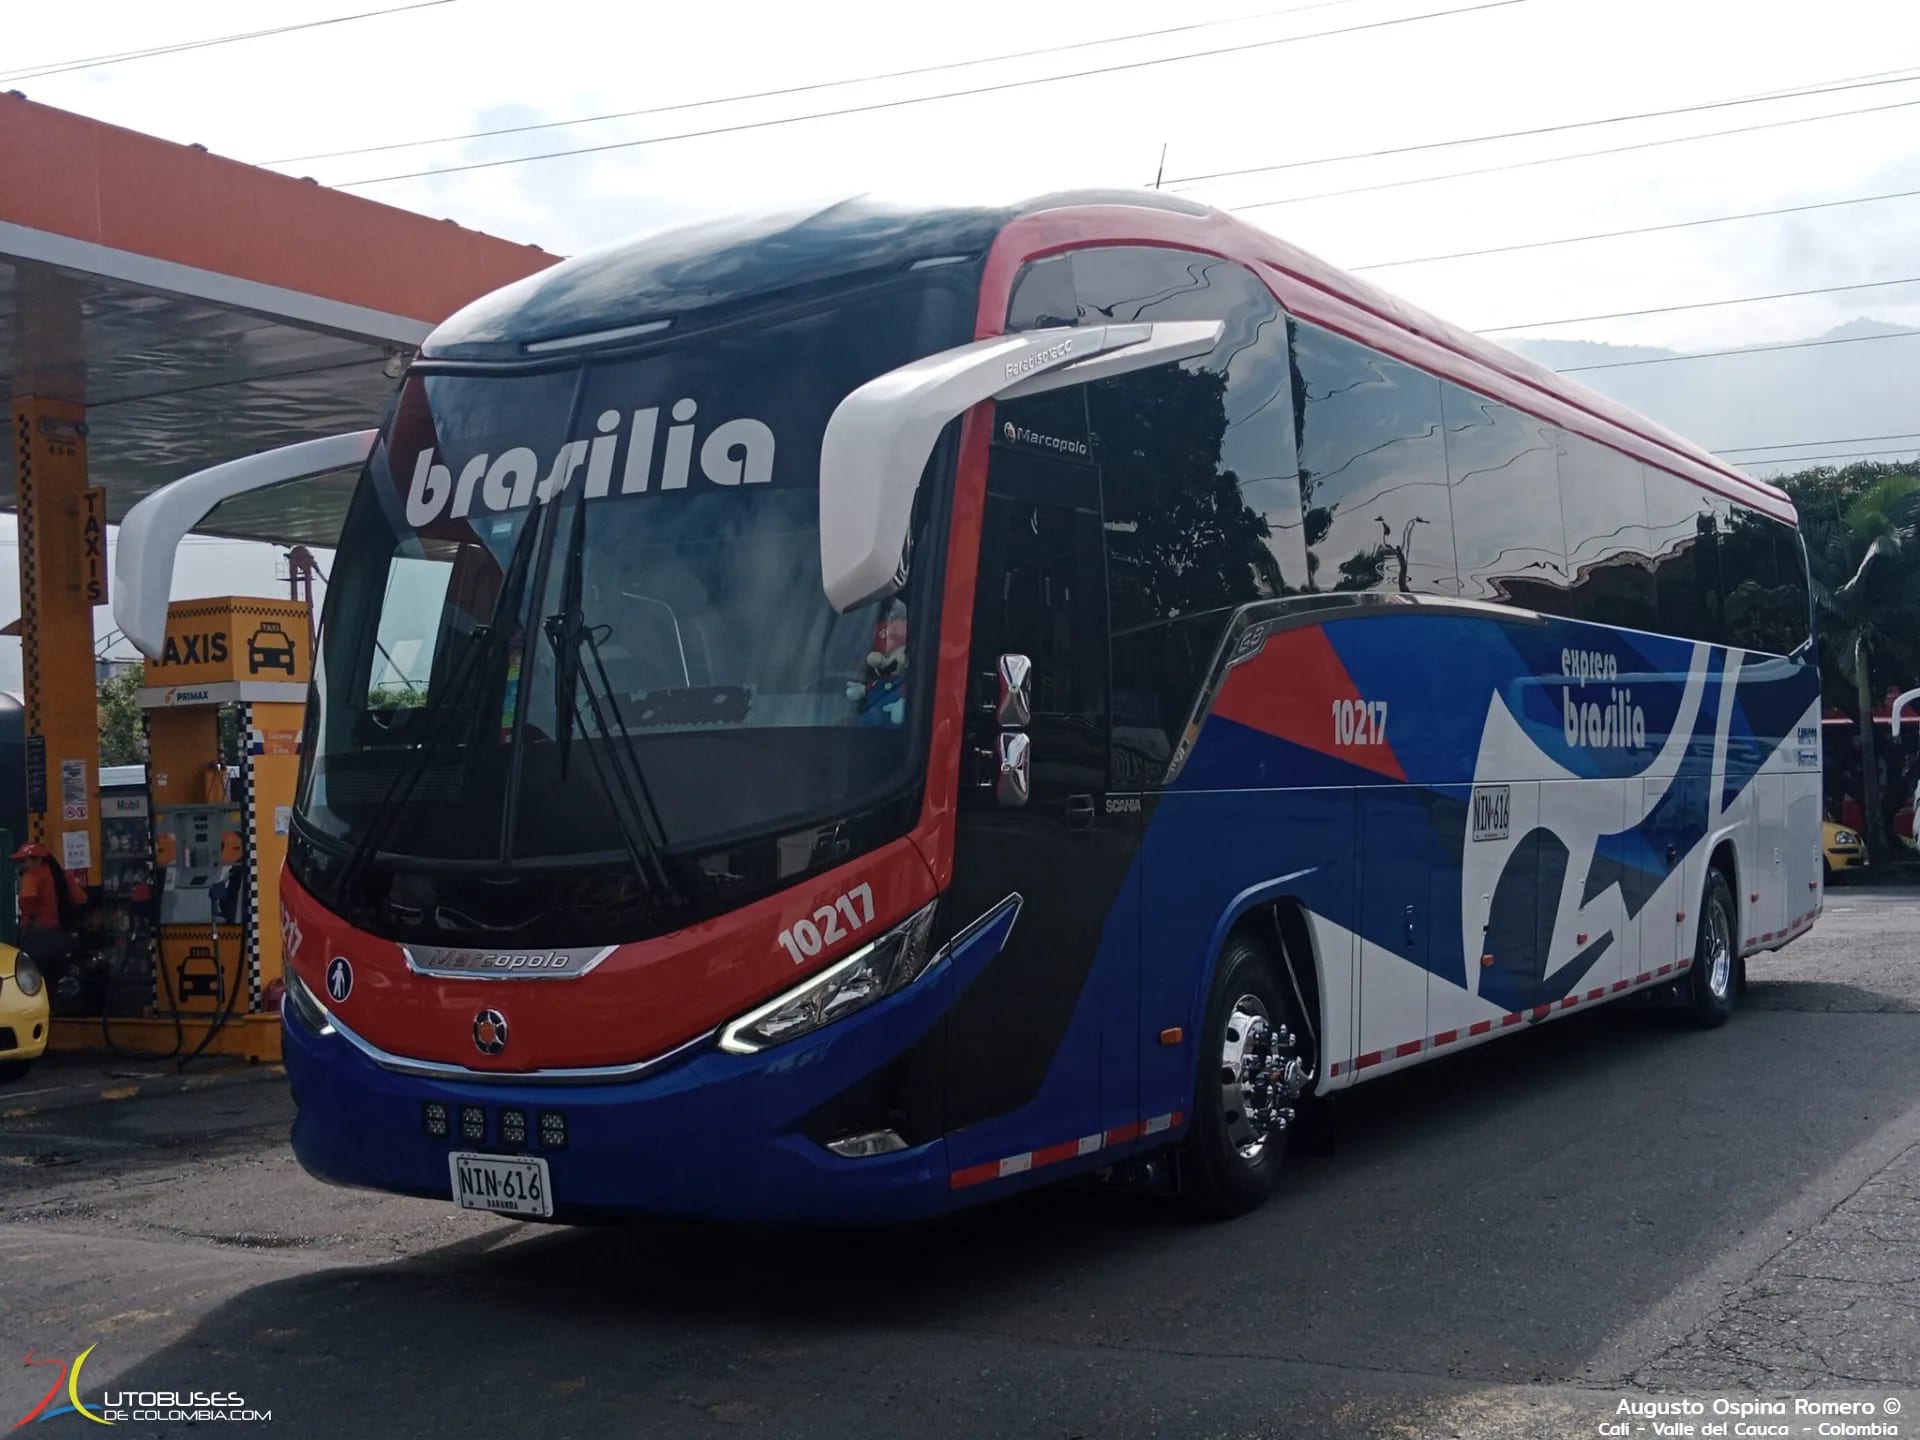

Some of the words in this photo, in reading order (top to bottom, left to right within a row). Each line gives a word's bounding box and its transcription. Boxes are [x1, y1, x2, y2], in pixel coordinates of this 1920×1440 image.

[1017, 428, 1087, 455] Marcopolo
[406, 398, 775, 527] brasilia
[83, 493, 101, 600] TAXIS
[262, 623, 280, 632] TAXI
[152, 631, 228, 667] AXIS
[1562, 648, 1617, 687] expreso
[177, 690, 209, 702] PRIMAX
[1332, 699, 1388, 745] 10217
[1562, 686, 1646, 748] brasilia
[1105, 799, 1141, 813] SCANIA
[778, 882, 875, 965] 10217
